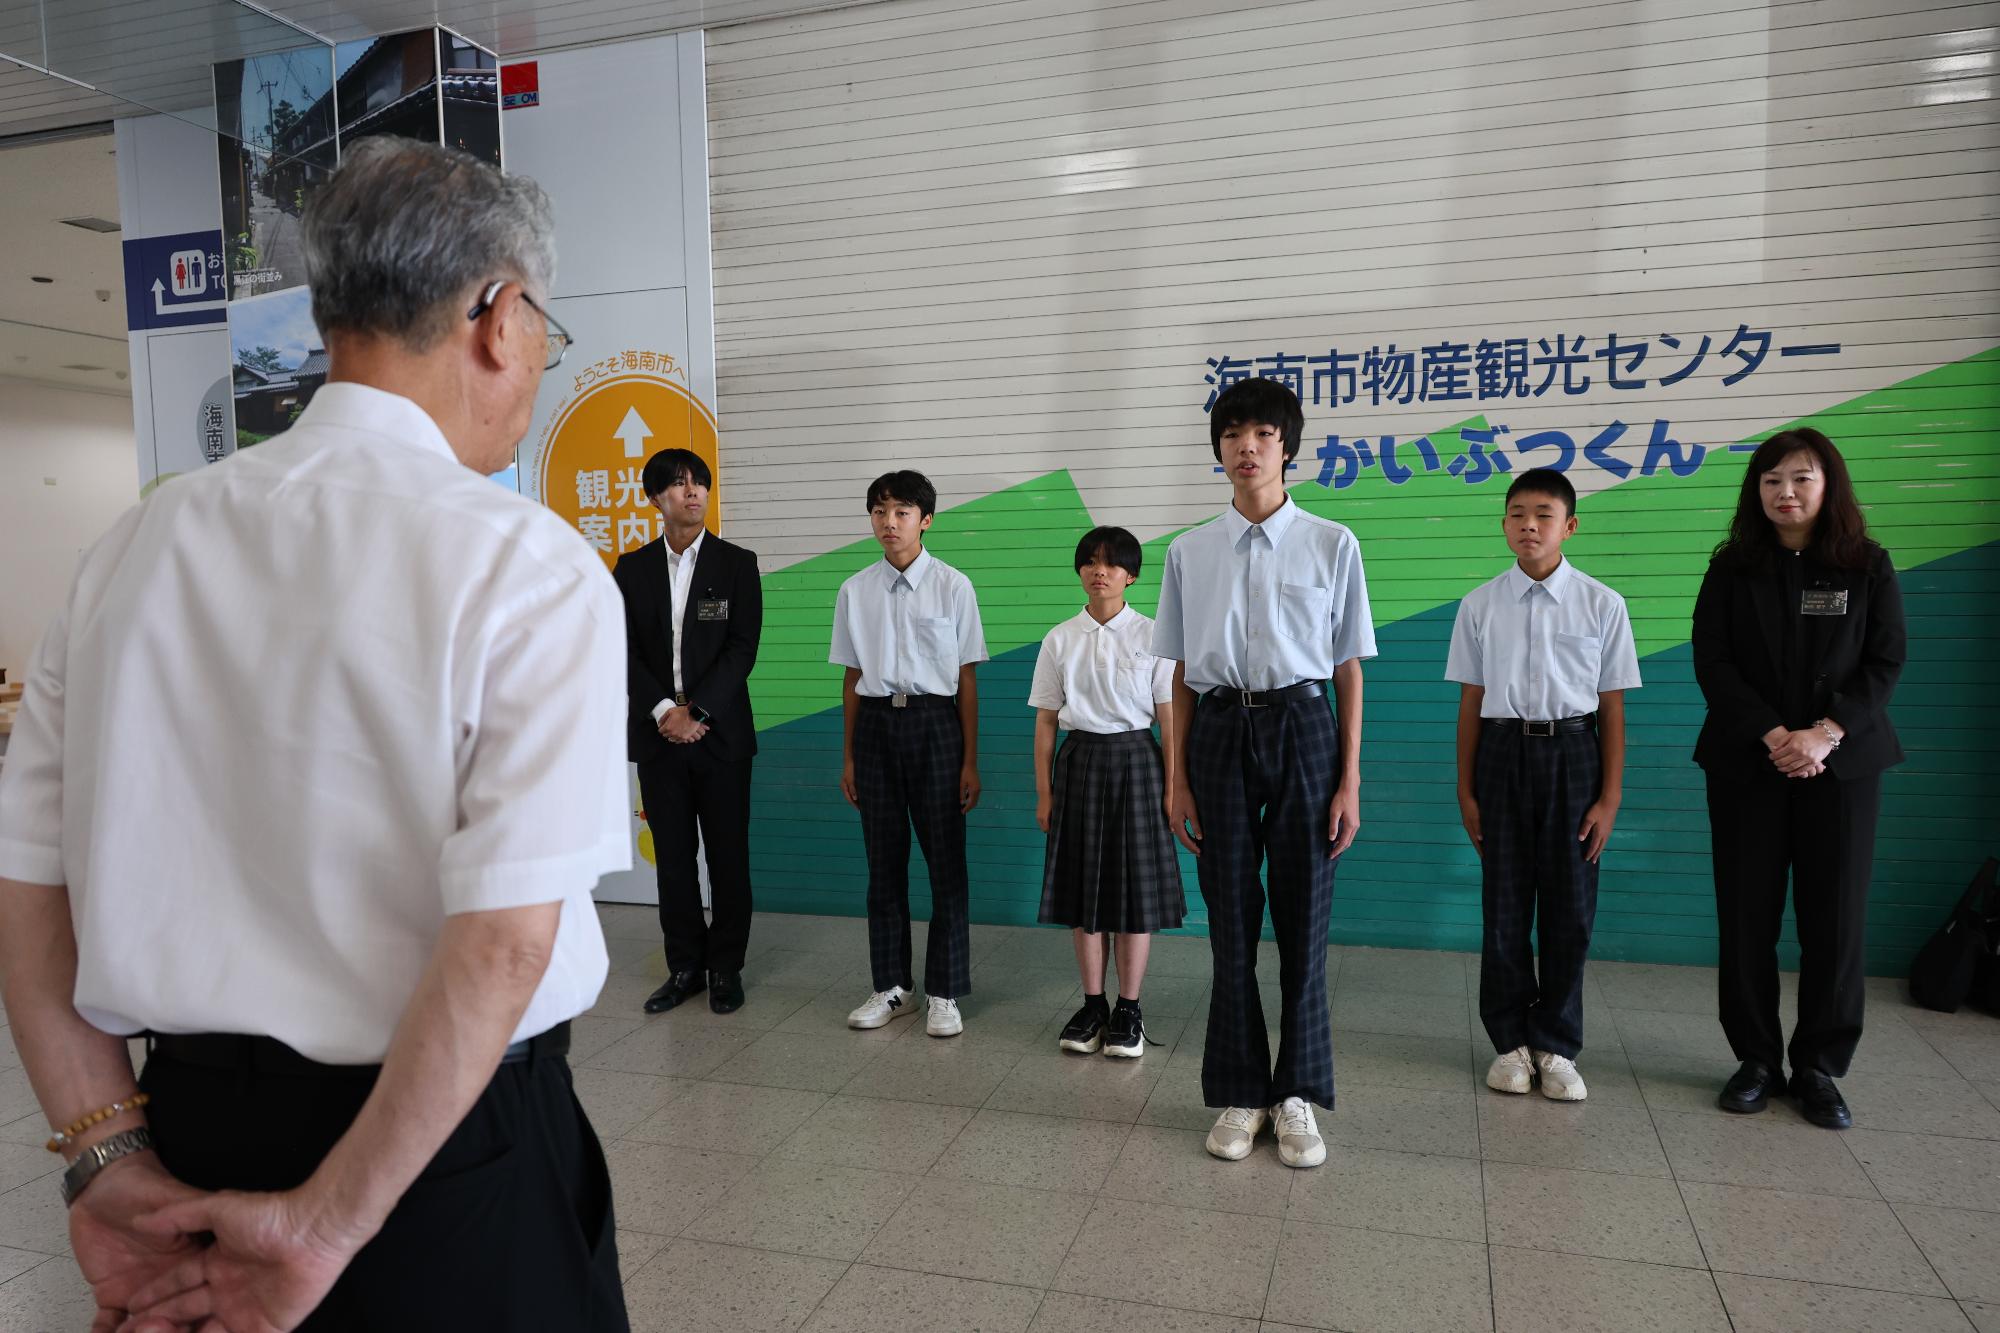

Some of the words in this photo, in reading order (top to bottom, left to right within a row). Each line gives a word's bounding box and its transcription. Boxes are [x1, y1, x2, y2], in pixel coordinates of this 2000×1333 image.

[503, 92, 537, 106] SEOM
[574, 350, 686, 392] ようこそ海南市へ
[1317, 419, 1706, 489] かいぶつくん
[578, 511, 664, 554] 案内
